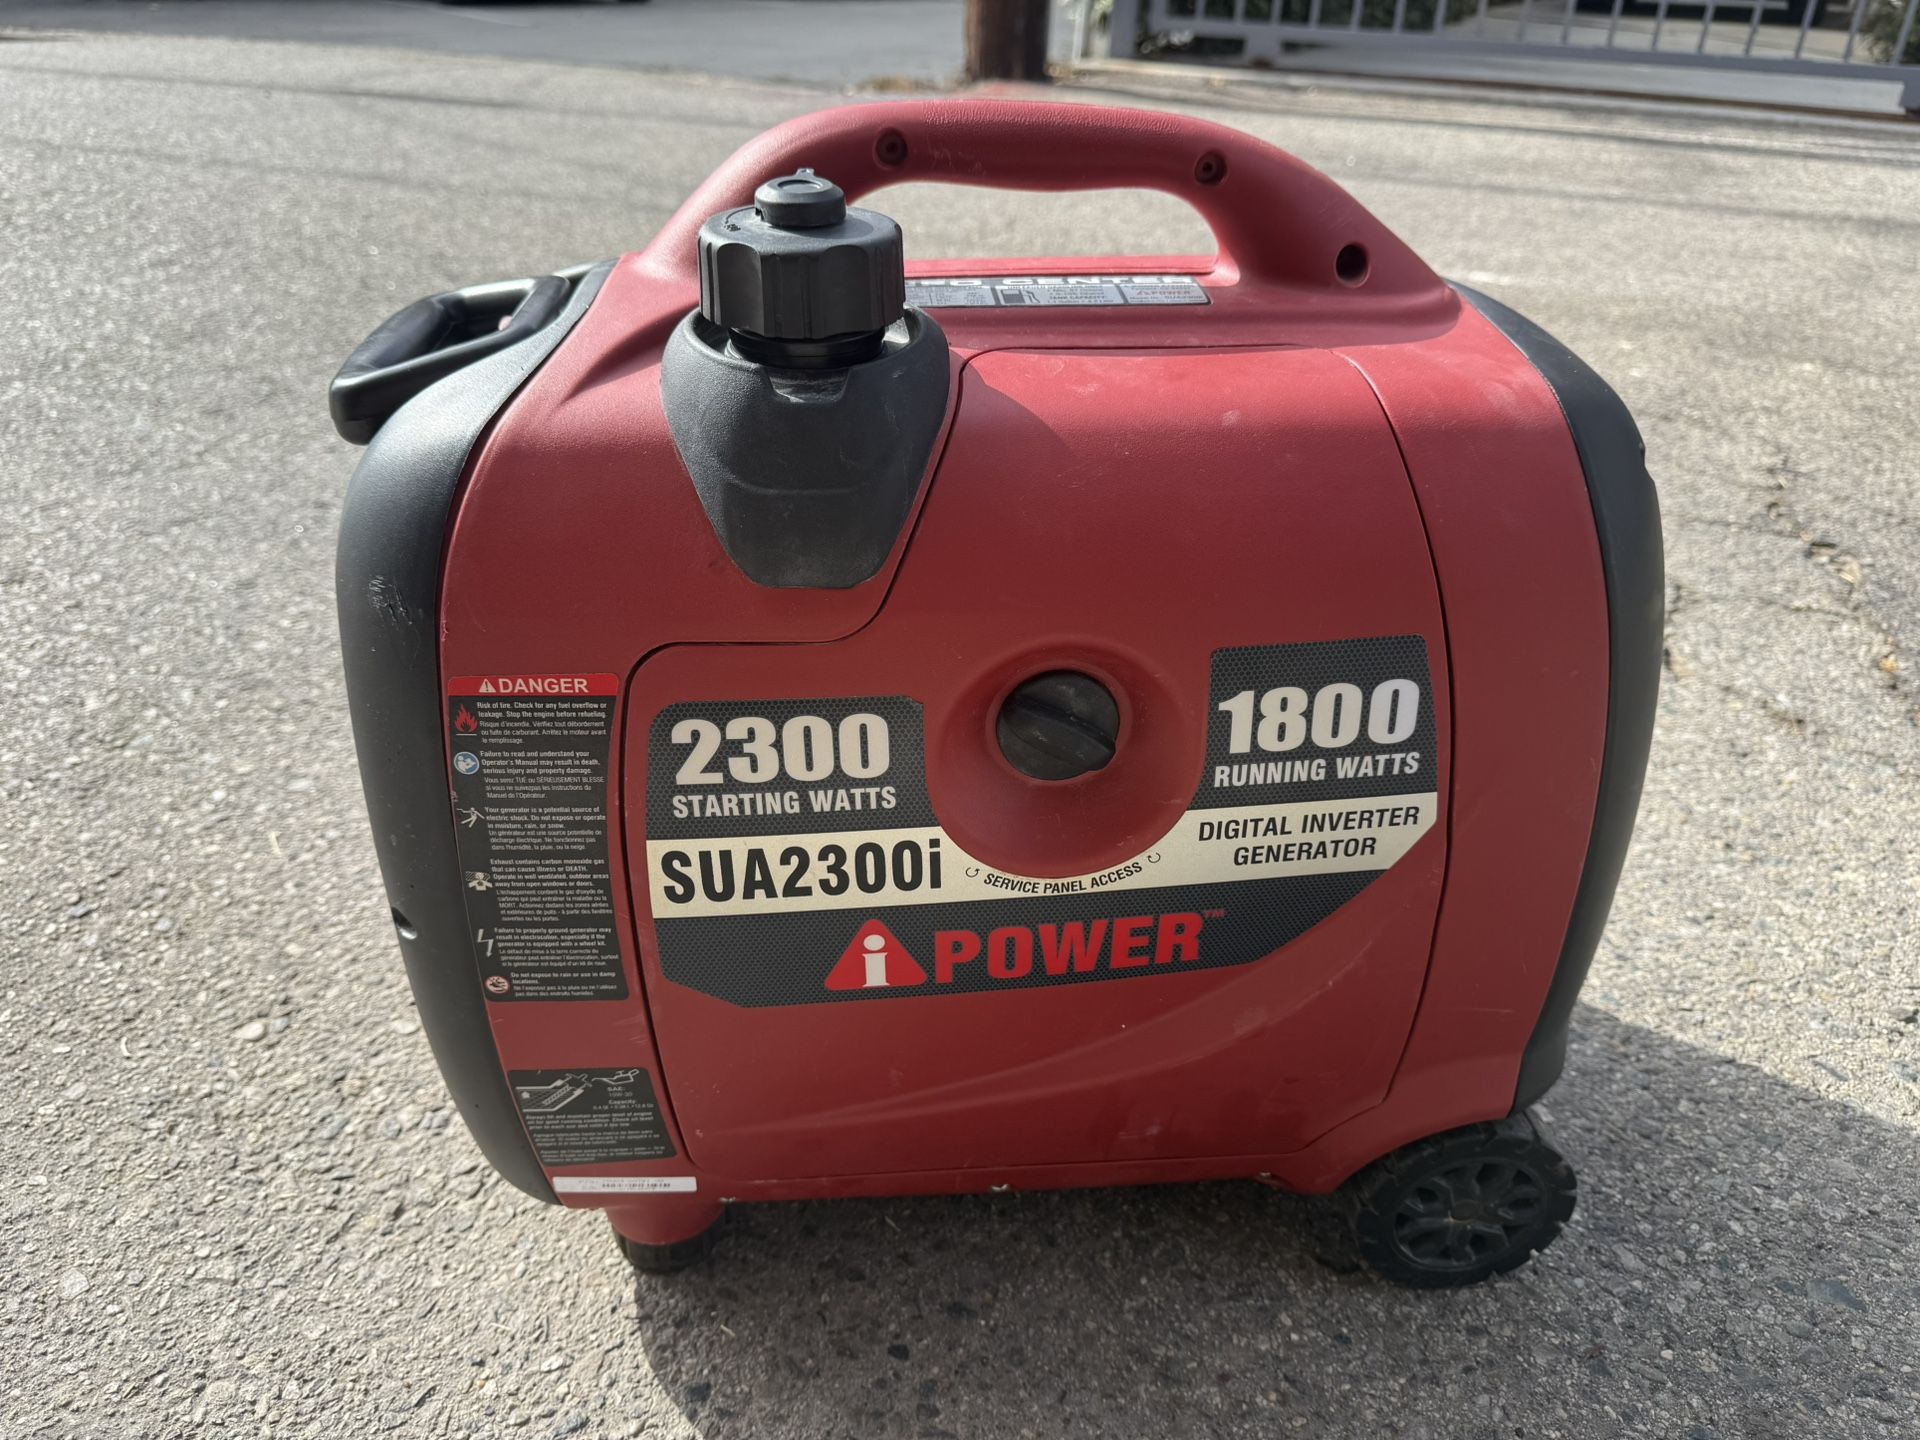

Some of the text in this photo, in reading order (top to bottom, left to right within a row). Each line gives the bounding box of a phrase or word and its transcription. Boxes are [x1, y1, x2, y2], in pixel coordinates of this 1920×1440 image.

[499, 678, 589, 693] DANGER
[1218, 678, 1420, 754] 1800
[671, 713, 890, 785] 2300
[1214, 751, 1420, 788] RUNNING WATTS
[672, 786, 896, 819] STARTING WATTS
[1198, 806, 1420, 841] DIGITAL INVERTER
[1234, 837, 1377, 866] GENERATOR
[661, 838, 942, 904] SUA2300i
[984, 862, 1142, 894] SERVICE PANEL ACCESS
[862, 934, 891, 987] i
[935, 912, 1203, 983] POWER
